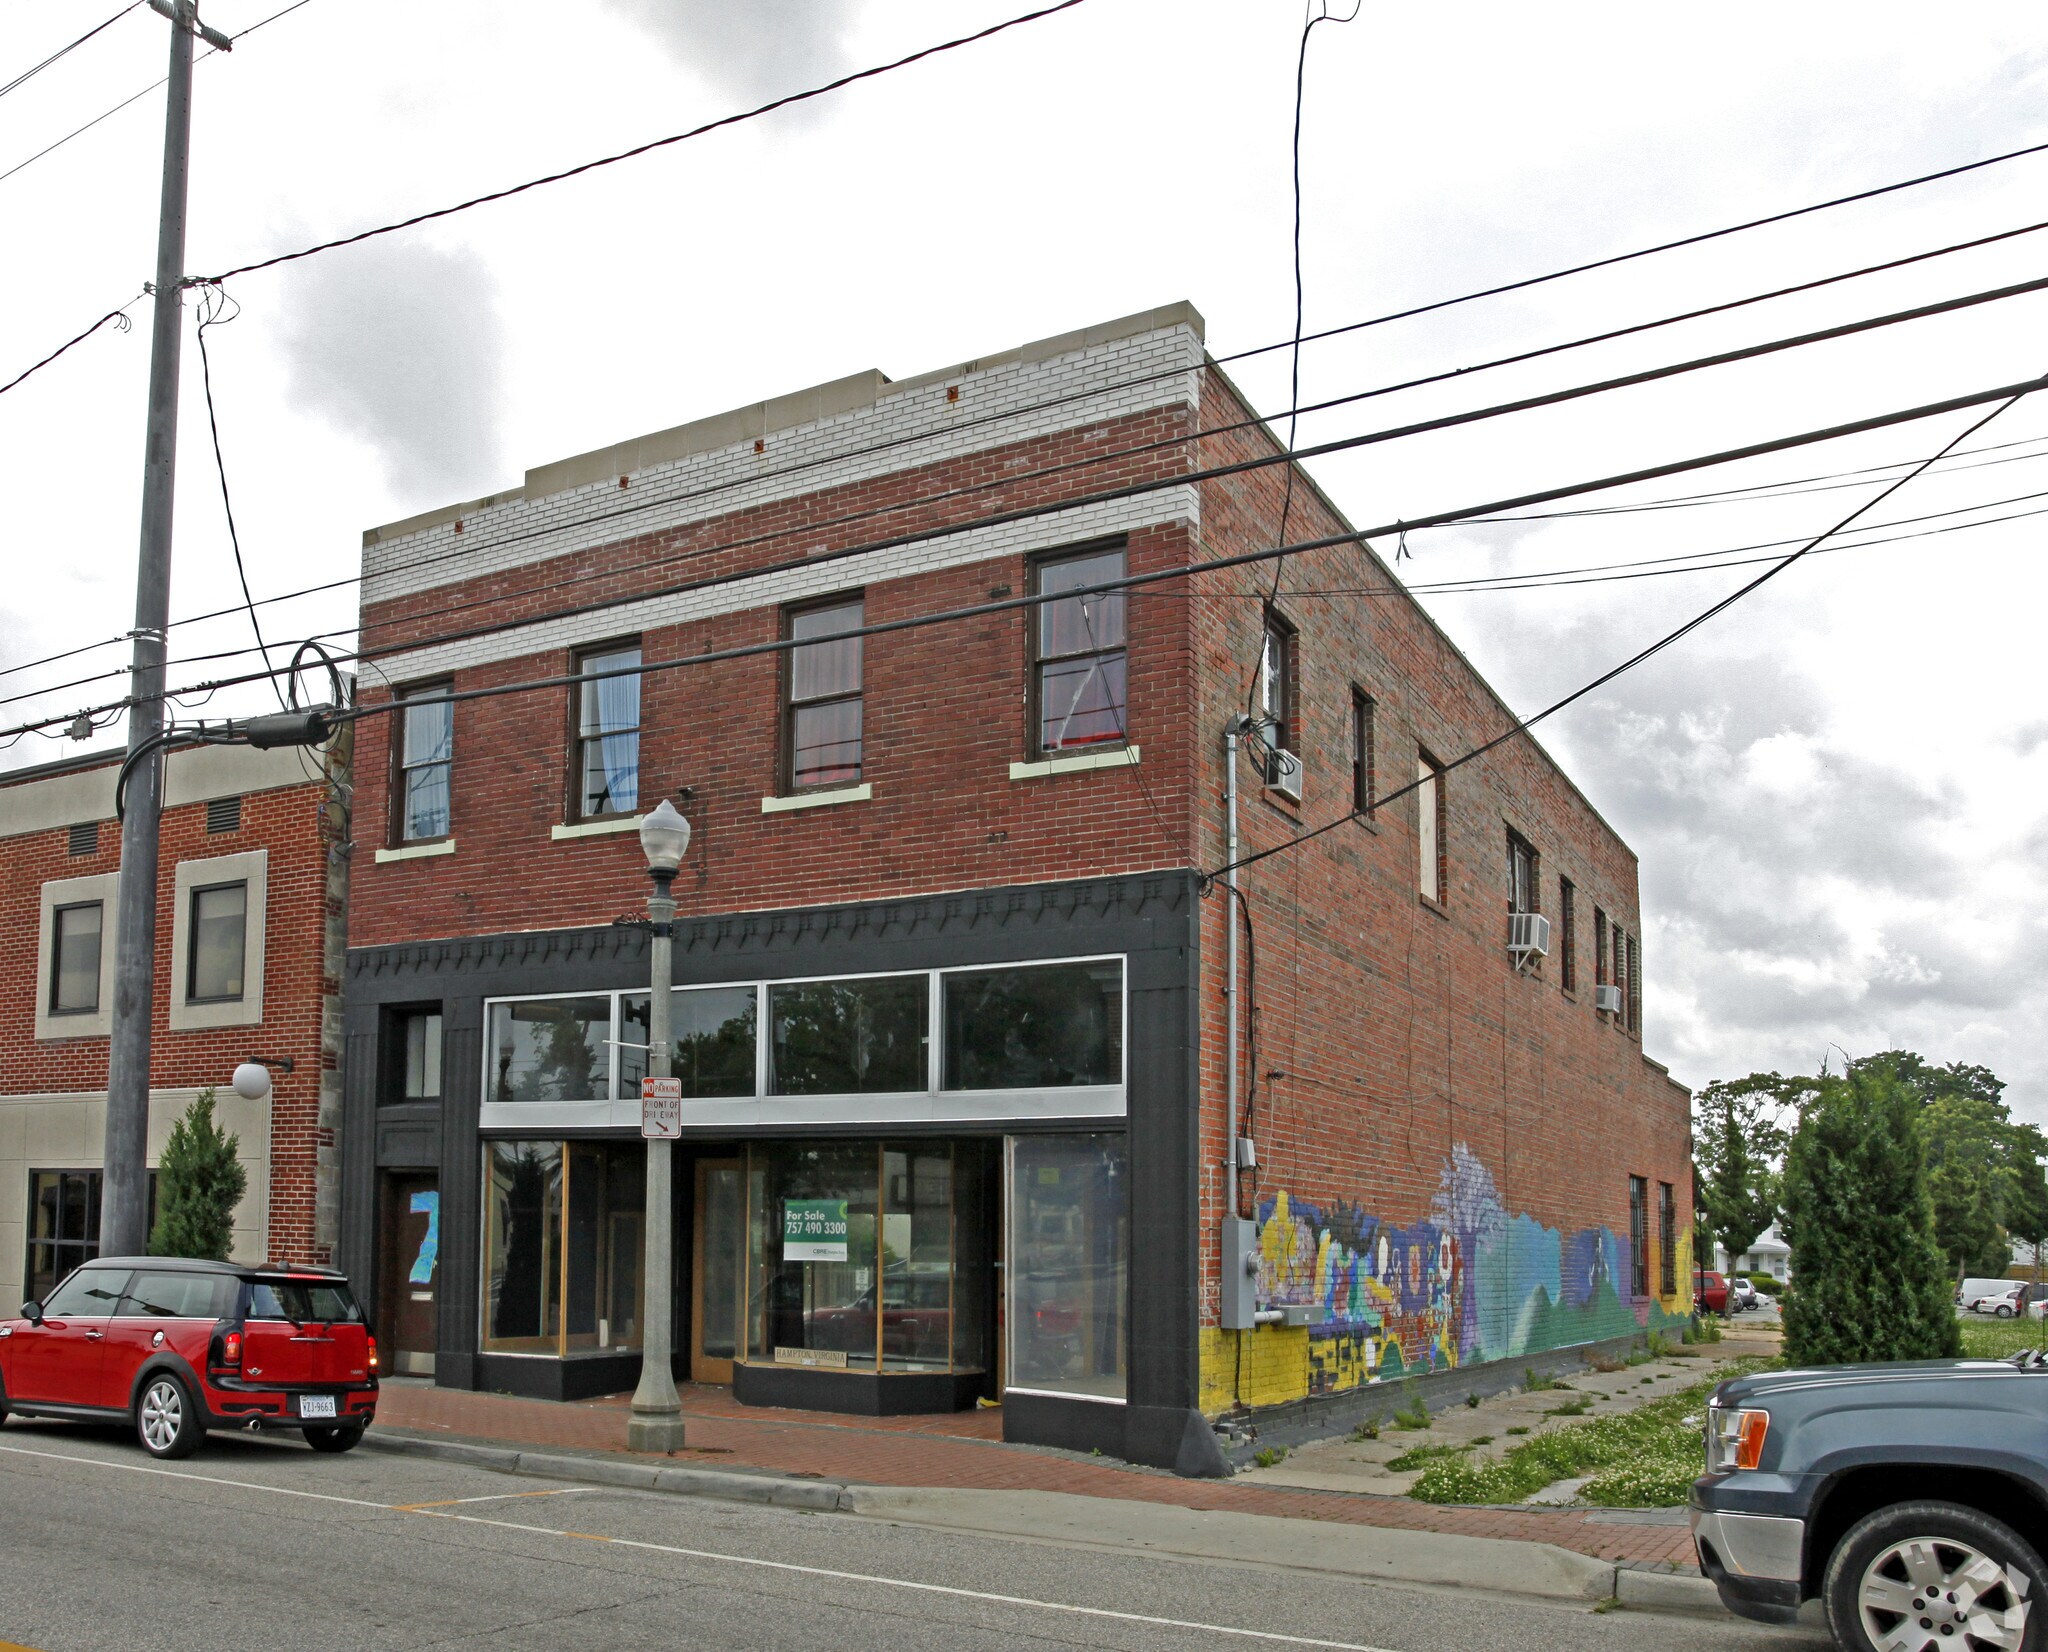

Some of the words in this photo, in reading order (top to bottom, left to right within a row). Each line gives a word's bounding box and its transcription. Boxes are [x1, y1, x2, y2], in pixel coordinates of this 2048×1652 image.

[643, 1082, 654, 1094] NO
[655, 1085, 679, 1093] PARKING
[645, 1100, 667, 1109] FRONT
[670, 1101, 679, 1109] OF
[645, 1110, 678, 1119] DRIEWAY
[786, 1210, 802, 1220] For
[804, 1210, 826, 1220] Sale
[786, 1221, 803, 1234] 757
[805, 1221, 822, 1234] 490
[824, 1222, 847, 1234] 3300
[814, 1351, 845, 1363] VIRGINIA
